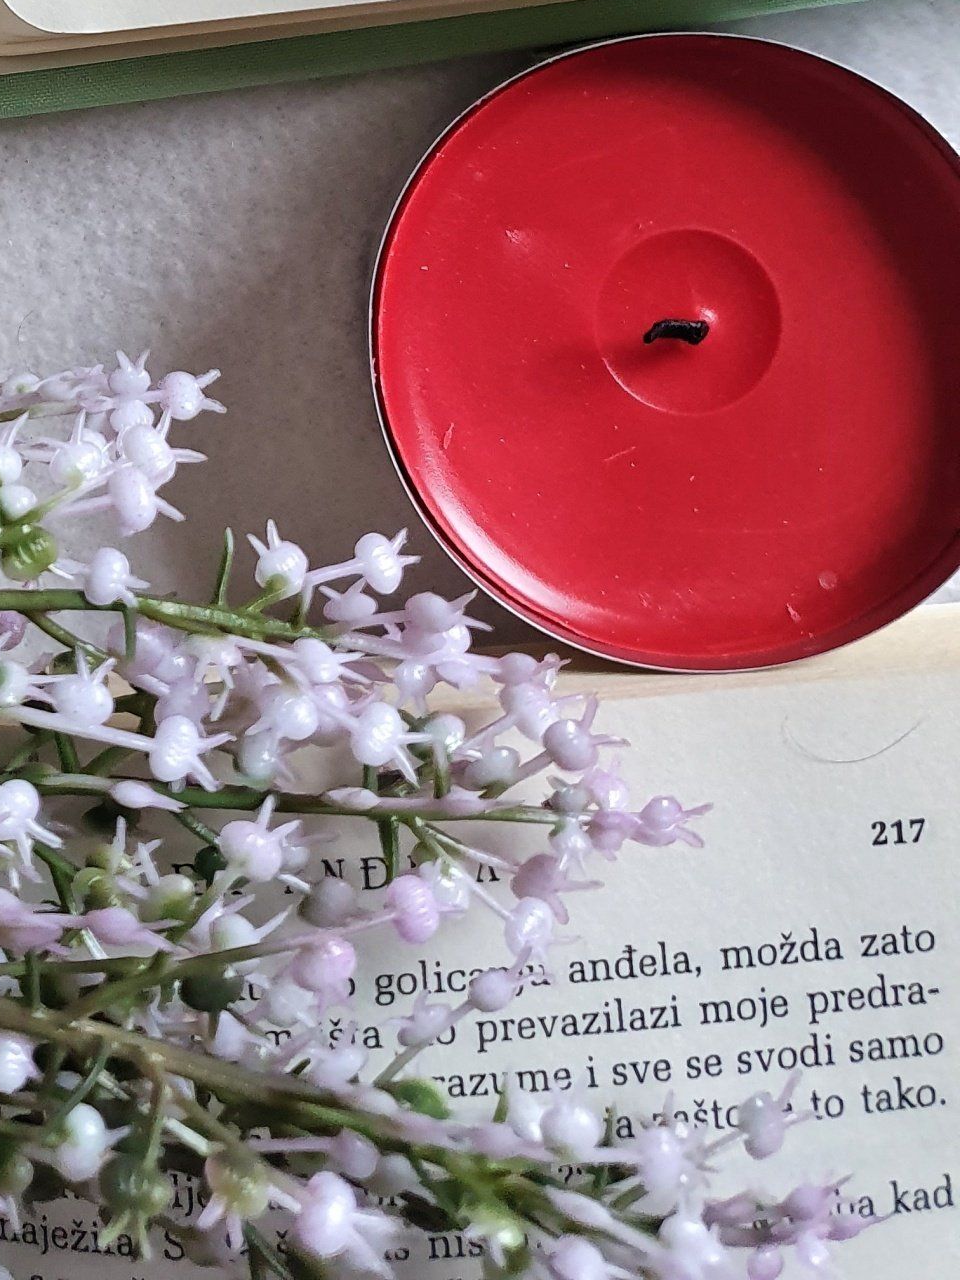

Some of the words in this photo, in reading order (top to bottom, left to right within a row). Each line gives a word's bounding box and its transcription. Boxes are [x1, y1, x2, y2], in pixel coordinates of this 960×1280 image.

[871, 817, 926, 847] 217
[568, 940, 702, 983] anđela,
[720, 927, 844, 970] možda
[860, 924, 936, 957] zato
[476, 994, 682, 1053] prevazilazi
[699, 987, 789, 1028] moje
[806, 973, 940, 1025] predra-
[587, 1056, 599, 1089] i
[611, 1059, 672, 1086] sve
[686, 1053, 722, 1080] se
[737, 1032, 836, 1075] svodi
[848, 1031, 944, 1064] samo
[810, 1089, 845, 1120] to
[861, 1076, 947, 1115] tako.
[889, 1172, 955, 1215] kad
